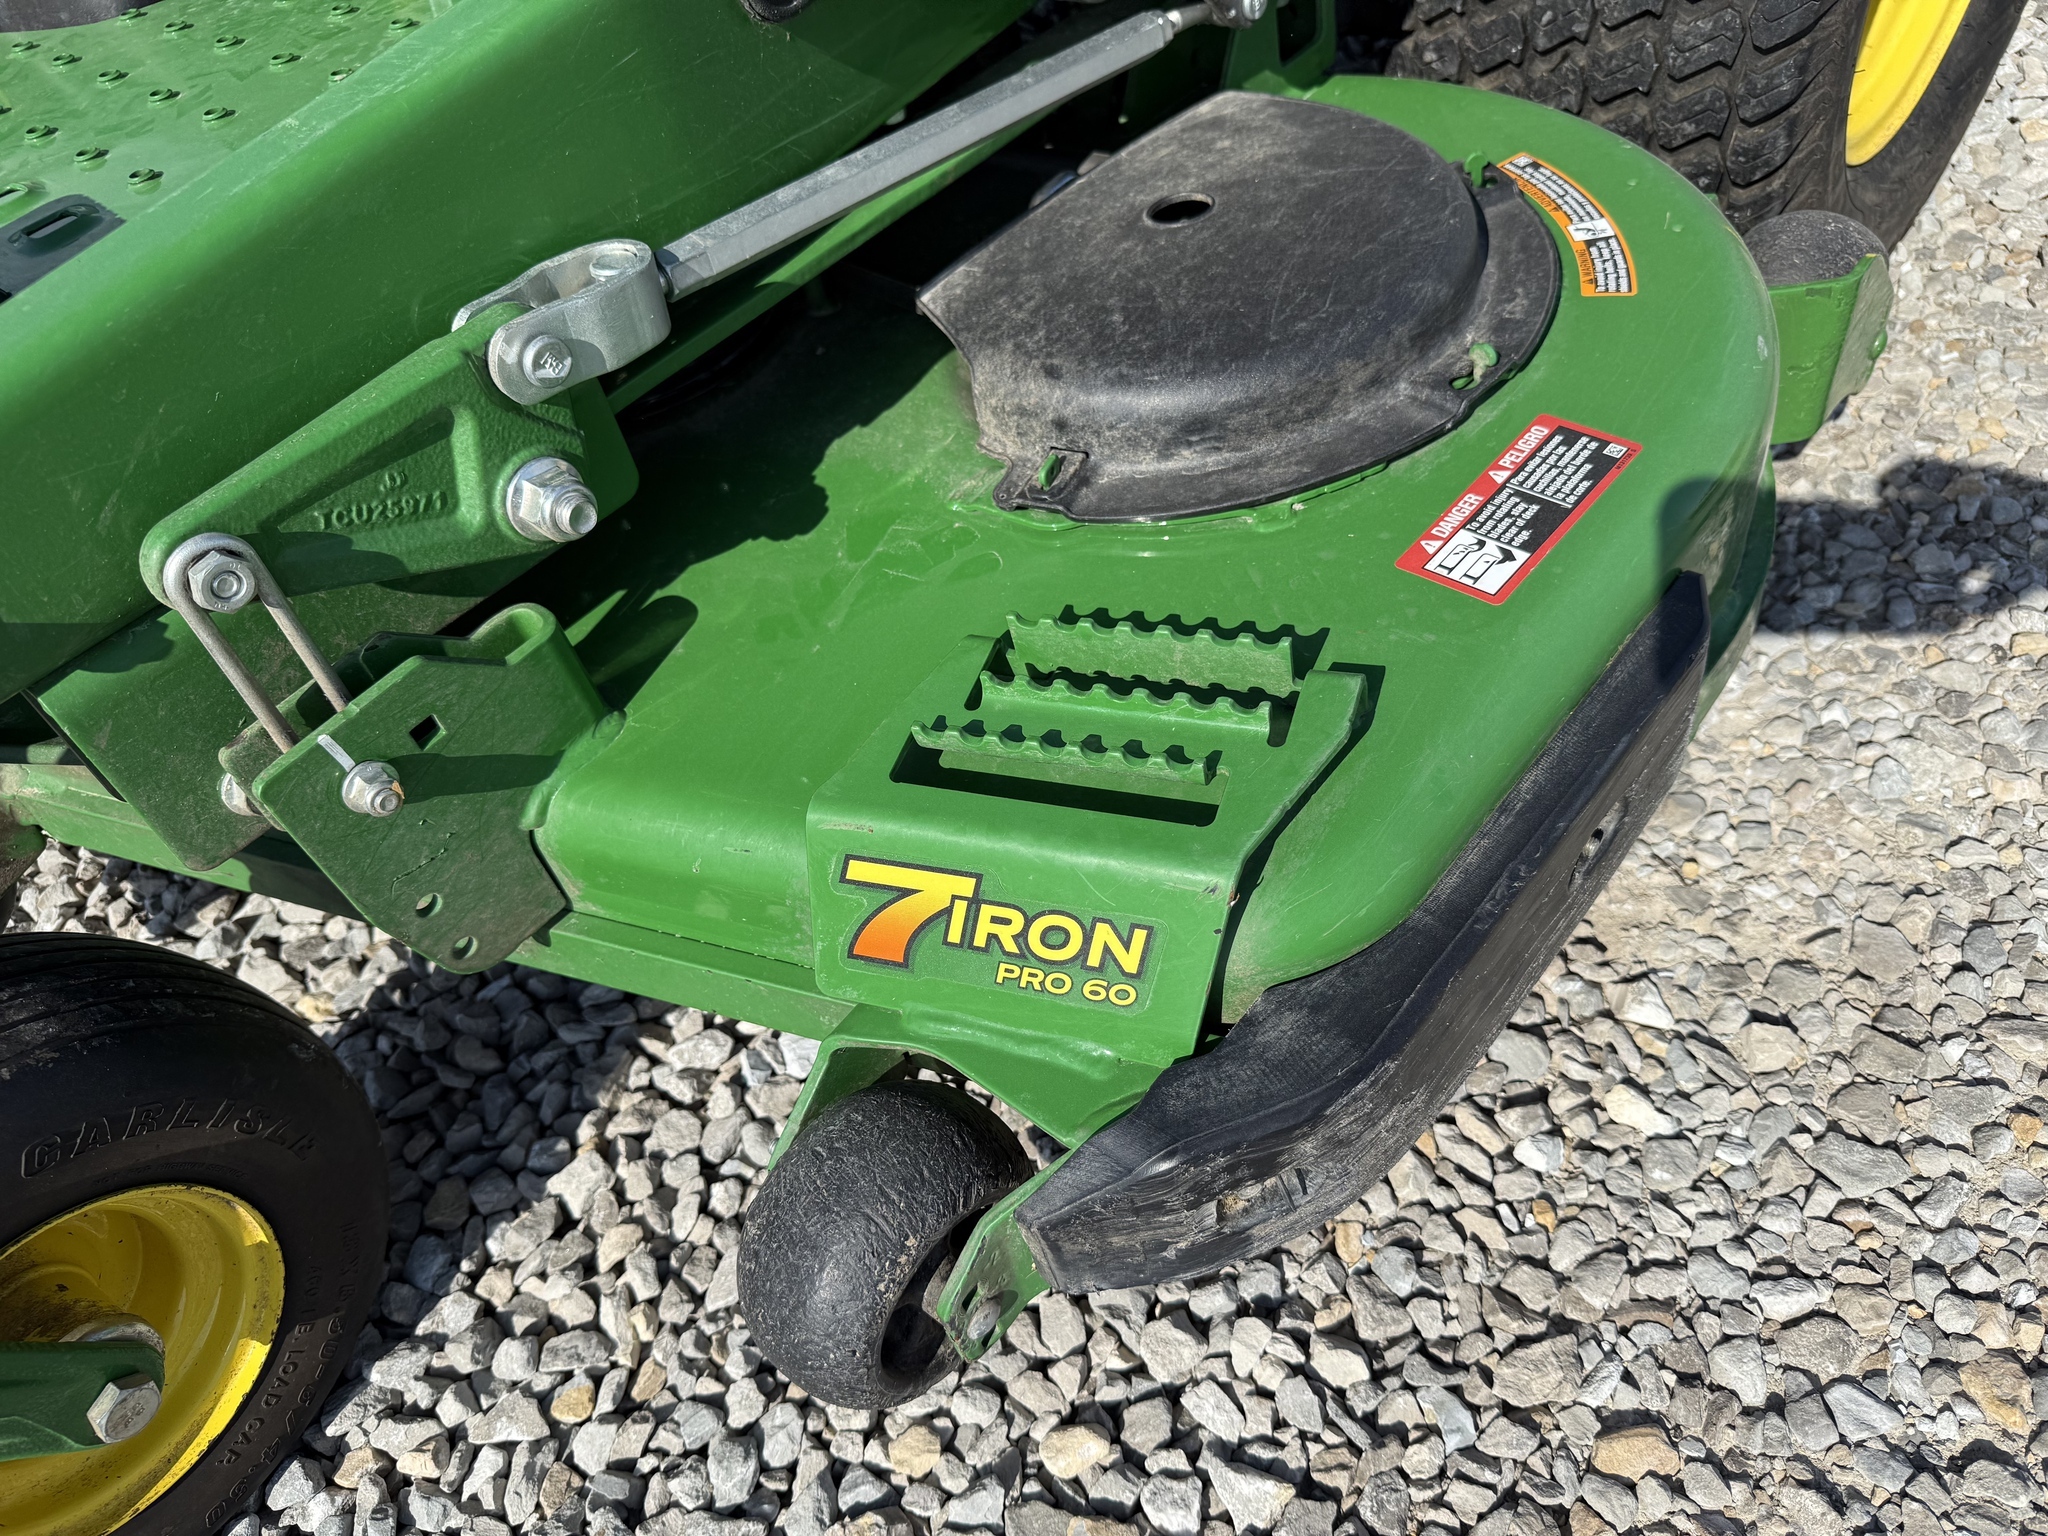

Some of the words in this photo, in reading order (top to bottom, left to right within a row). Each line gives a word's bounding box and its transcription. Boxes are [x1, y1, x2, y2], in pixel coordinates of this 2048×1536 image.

[1576, 249, 1595, 277] WARNING
[1497, 424, 1549, 469] PELIGRO
[1509, 470, 1529, 485] Para
[1522, 455, 1543, 472] evitar
[1536, 434, 1564, 457] lesiones
[1545, 454, 1560, 465] por
[1552, 444, 1568, 455] las
[1555, 435, 1590, 467] mantenerse
[1520, 462, 1550, 488] causadas
[1542, 473, 1570, 496] alejado
[1561, 464, 1577, 475] del
[1570, 448, 1592, 465] borde
[1585, 440, 1599, 450] de
[1559, 462, 1594, 494] plataforma
[1430, 492, 1484, 538] DANGER
[1465, 520, 1481, 531] To
[1473, 504, 1496, 522] avoid
[1489, 486, 1515, 506] injury
[1476, 519, 1497, 535] from
[1490, 495, 1520, 521] rotating
[1509, 502, 1529, 516] stay
[1553, 492, 1566, 500] la
[1564, 494, 1578, 504] de
[1498, 525, 1520, 543] clear
[1513, 517, 1527, 526] of
[1520, 503, 1540, 519] deck
[1510, 528, 1533, 547] edge.
[840, 854, 983, 969] 7
[942, 896, 1154, 979] IRON
[995, 961, 1073, 996] PRO
[1081, 978, 1138, 1007] 60
[20, 1097, 320, 1179] CARLISLE
[261, 1348, 306, 1408] LOAD
